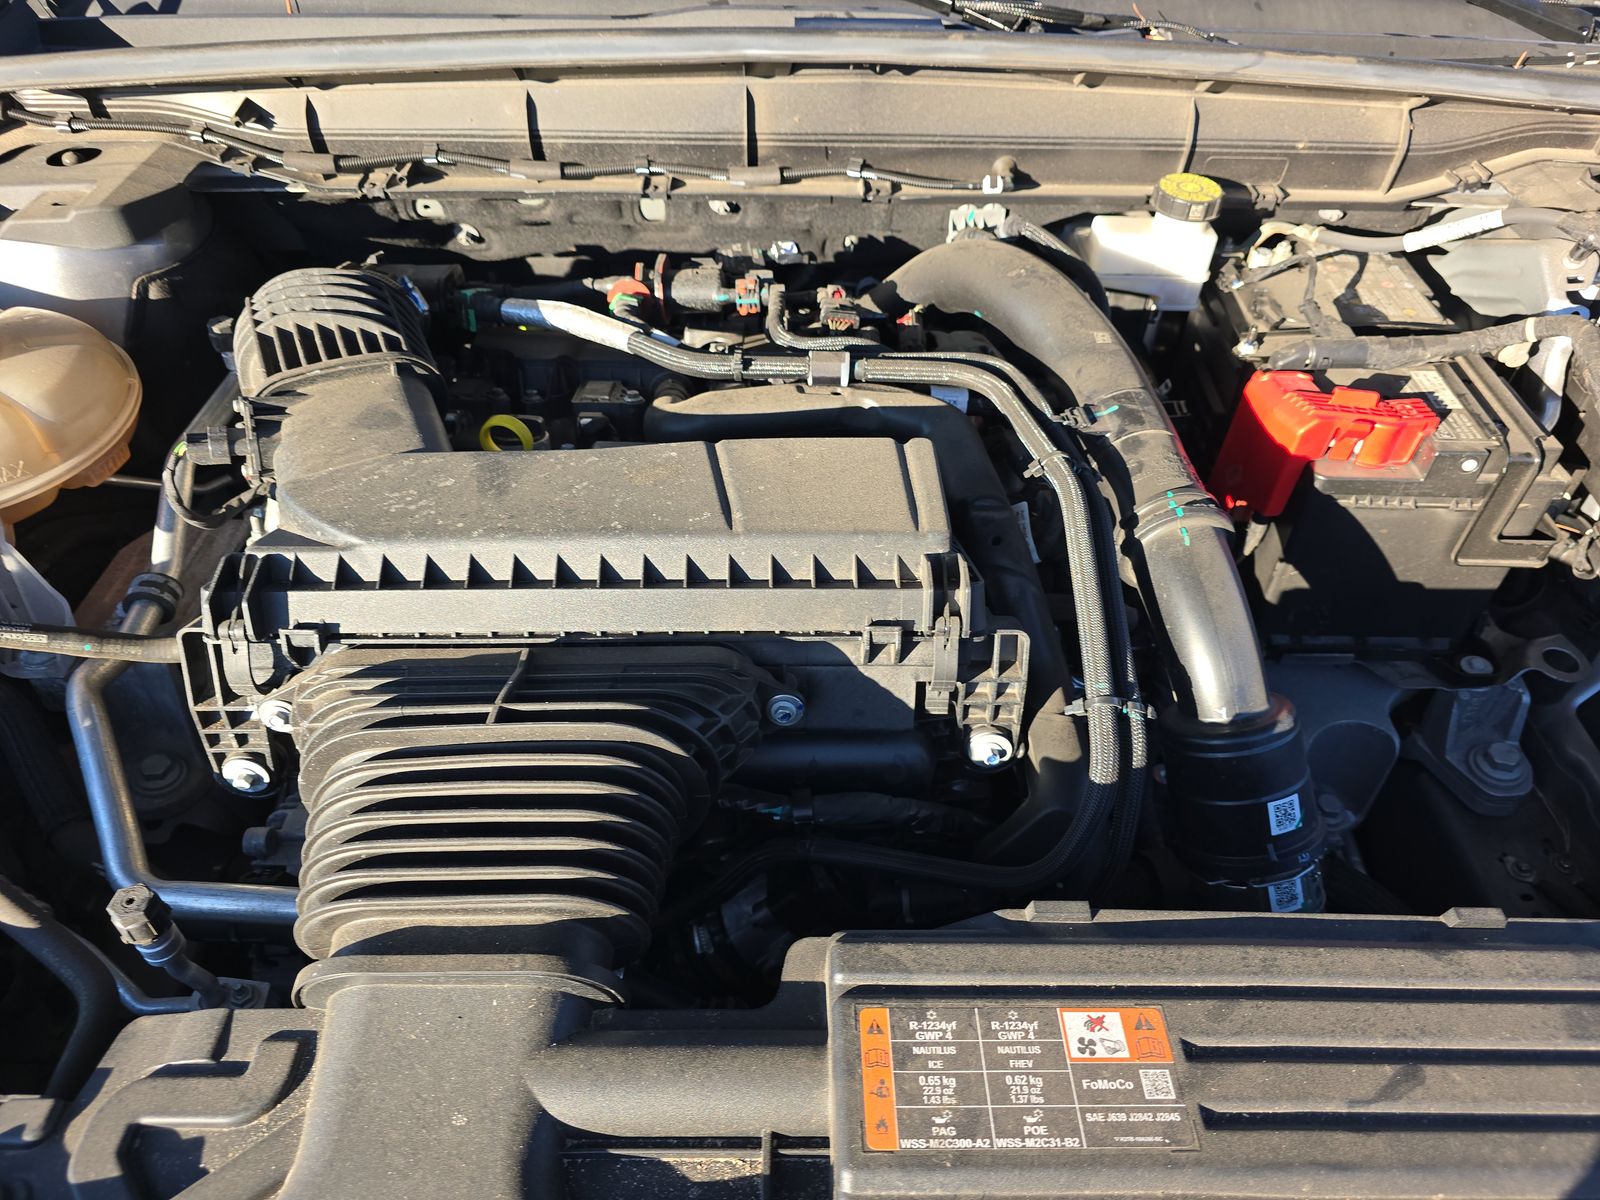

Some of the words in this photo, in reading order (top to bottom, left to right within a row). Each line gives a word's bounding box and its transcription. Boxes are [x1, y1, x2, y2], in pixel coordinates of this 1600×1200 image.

[0, 461, 33, 483] AX
[909, 1021, 957, 1031] R-1234yf
[991, 1021, 1039, 1031] R-1234yf
[915, 1031, 943, 1040] GWP
[945, 1031, 953, 1040] 4
[998, 1031, 1025, 1040] GWP
[1027, 1031, 1035, 1040] 4
[912, 1046, 957, 1055] NAUTILUS
[997, 1046, 1042, 1054] NAUTILUS
[927, 1060, 944, 1069] ICE
[1009, 1059, 1034, 1068] FHEV
[918, 1075, 941, 1086] 0.65
[942, 1075, 956, 1088] kg
[1005, 1075, 1028, 1085] 0.62
[1029, 1075, 1043, 1087] kg
[1081, 1079, 1134, 1089] FoMoCo
[922, 1087, 941, 1095] 22.9
[1010, 1086, 1029, 1095] 21.9
[1030, 1087, 1042, 1095] oz
[922, 1095, 941, 1105] 1.43
[942, 1095, 956, 1105] lbs
[1011, 1095, 1029, 1104] 1.37
[1029, 1095, 1045, 1104] lbs
[1085, 1113, 1105, 1121] SAE
[1106, 1113, 1128, 1121] J639
[931, 1127, 957, 1136] PAG
[1023, 1126, 1049, 1135] POE
[900, 1139, 991, 1149] WSS-M2C300-A2
[996, 1138, 1082, 1148] WSS-M2C31-B2
